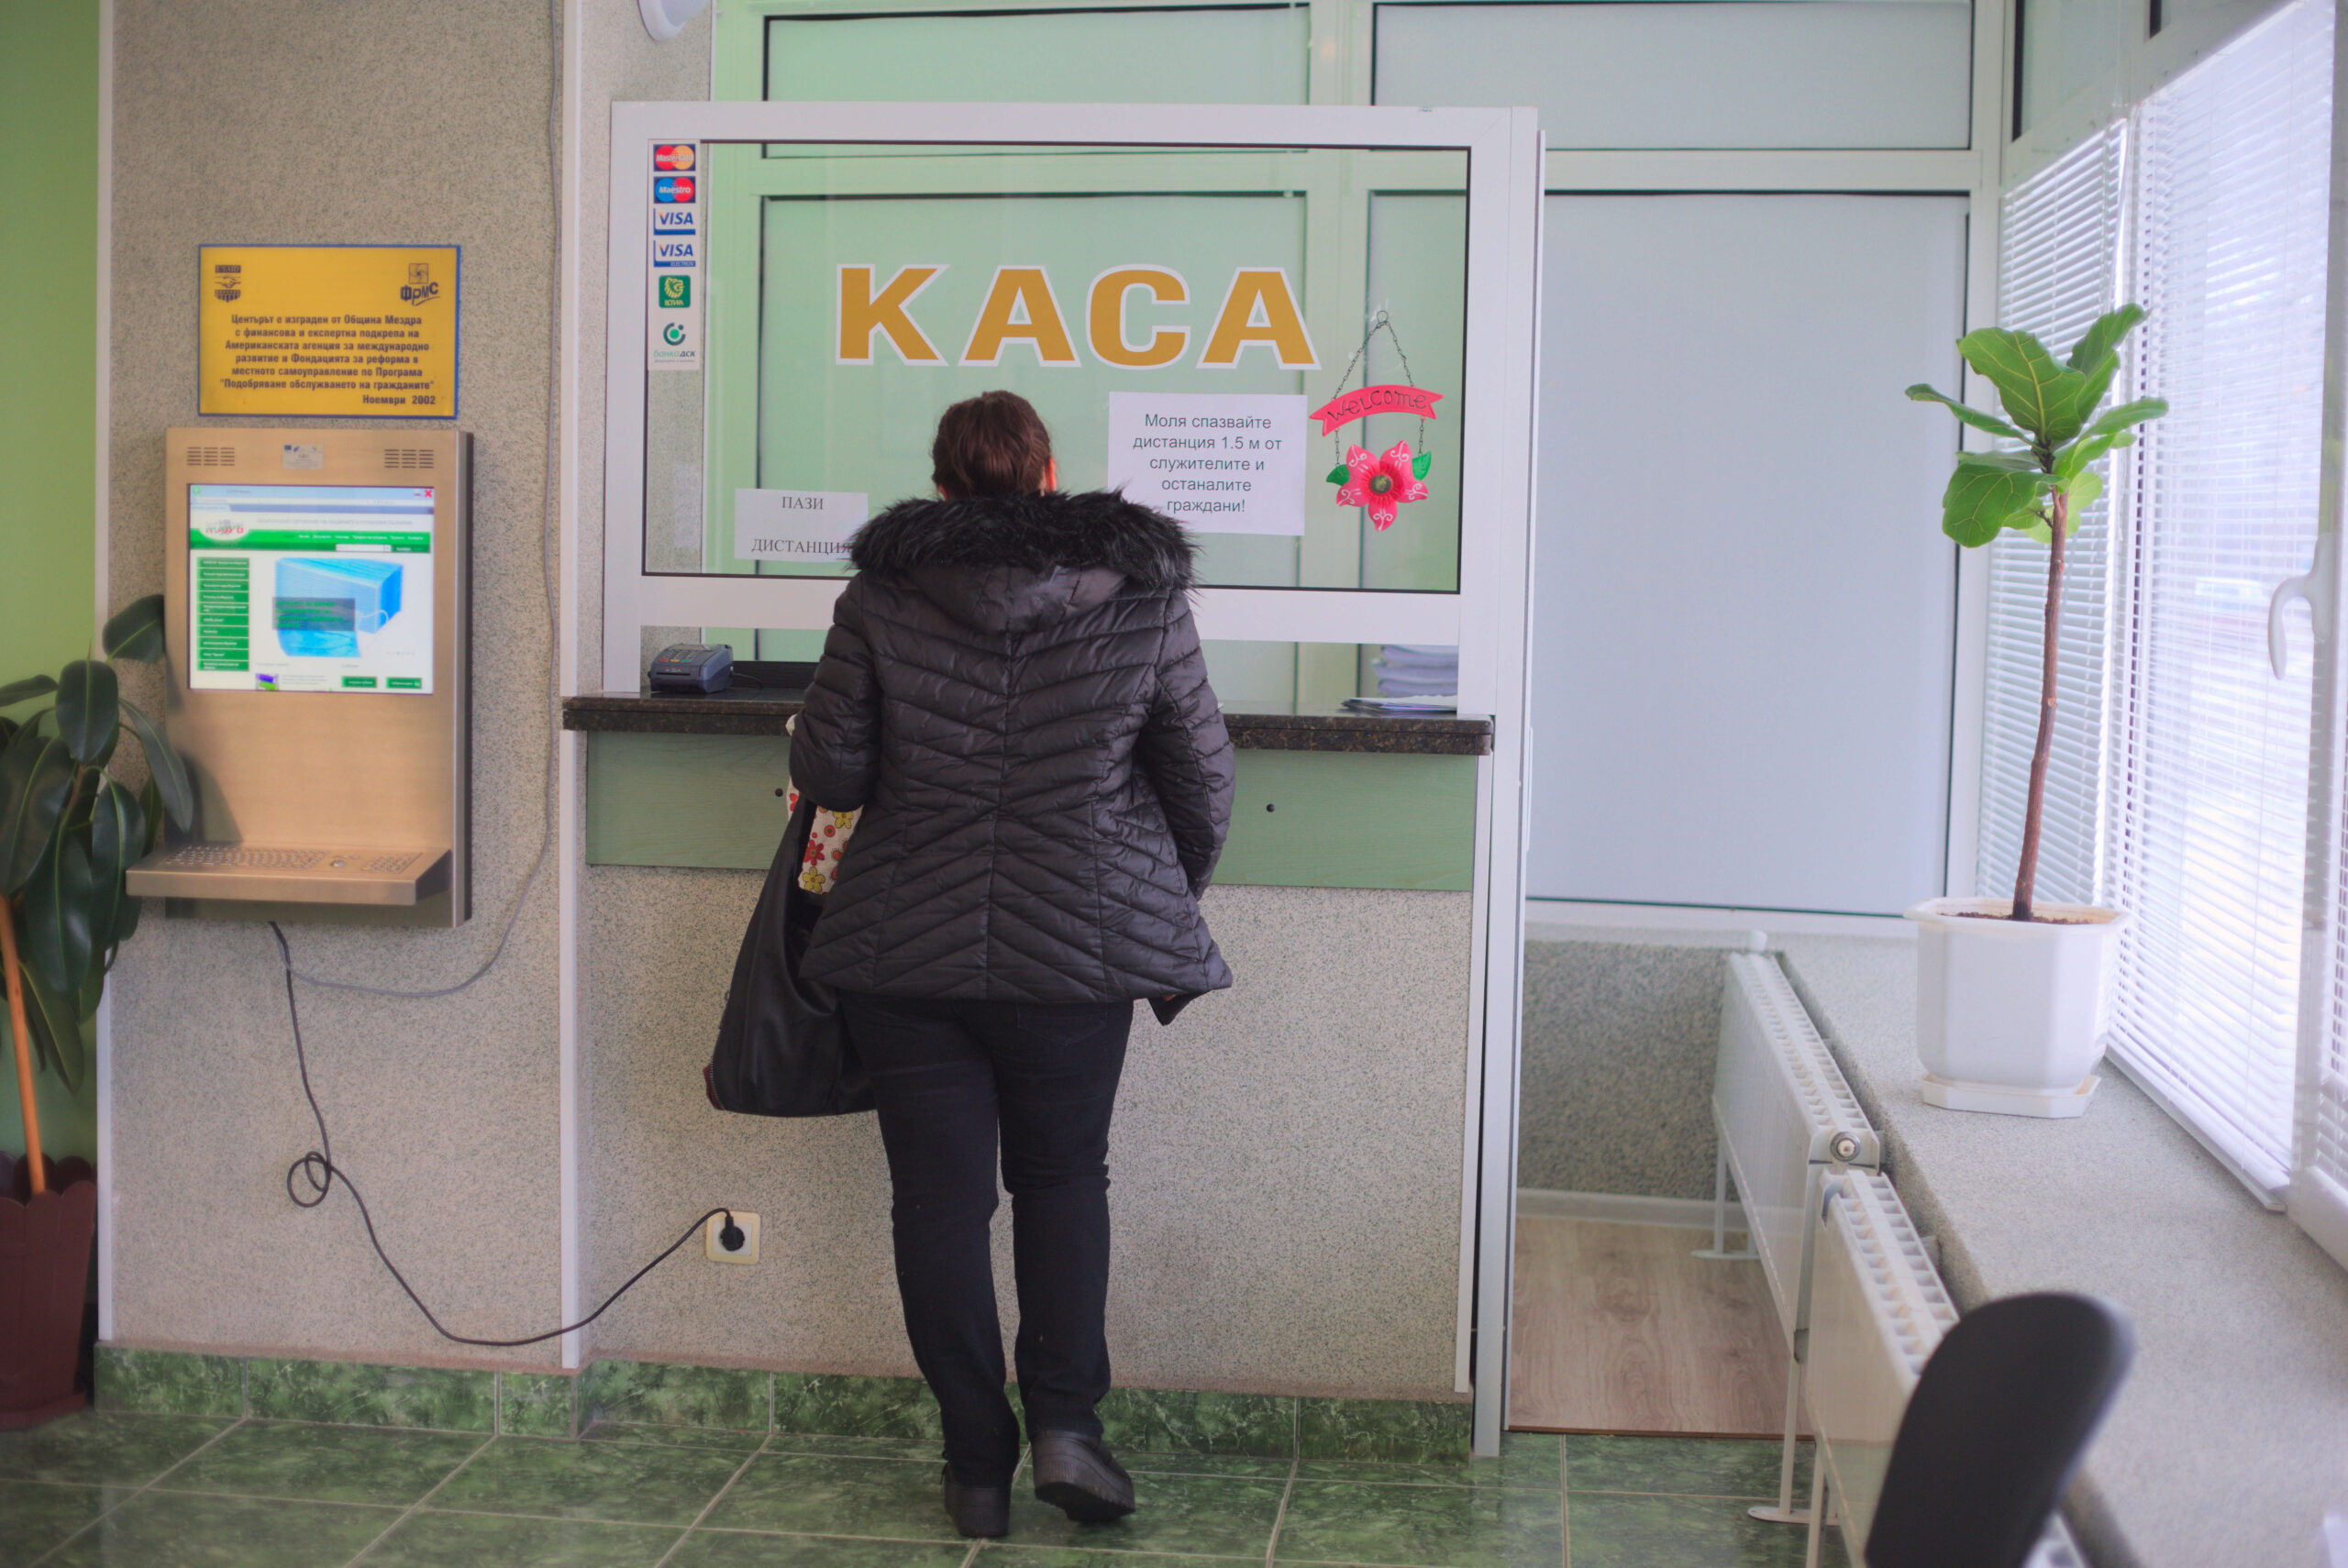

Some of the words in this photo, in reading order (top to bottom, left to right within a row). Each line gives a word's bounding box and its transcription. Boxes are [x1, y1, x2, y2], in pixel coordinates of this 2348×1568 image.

[659, 186, 692, 195] Maestro
[659, 212, 694, 225] VISA
[659, 244, 694, 257] VISA
[231, 315, 274, 326] Центърът
[285, 316, 328, 326] изграден
[344, 315, 382, 326] Община
[385, 315, 422, 326] Мездра
[836, 263, 1322, 370] КАСА
[244, 327, 295, 338] финансова
[308, 330, 356, 339] експертна
[360, 330, 404, 340] подкрепа
[226, 340, 299, 351] Американската
[302, 343, 340, 352] агенция
[357, 343, 429, 353] международно
[236, 355, 279, 364] развитие
[291, 353, 349, 364] Фондацията
[367, 354, 410, 365] реформа
[231, 368, 275, 376] местното
[278, 368, 358, 378] самоуправление
[375, 367, 423, 378] Програма
[220, 379, 286, 390] "Подобряване
[290, 380, 356, 391] обслужването
[373, 381, 434, 391] гражданите"
[362, 395, 405, 406] Ноември
[412, 395, 436, 405] 2002
[1145, 414, 1187, 428] Моля
[1191, 415, 1271, 432] спазвайте
[1133, 436, 1214, 450] дистанция
[1221, 436, 1244, 449] 1.5
[1248, 440, 1260, 449] м
[1265, 440, 1282, 449] от
[1149, 459, 1250, 474] служителите
[1256, 460, 1264, 470] и
[1161, 480, 1251, 491] останалите
[781, 496, 824, 510] ПАЗИ
[1167, 500, 1246, 513] граждани!
[751, 538, 851, 556] ДИСТАНЦИЯ
